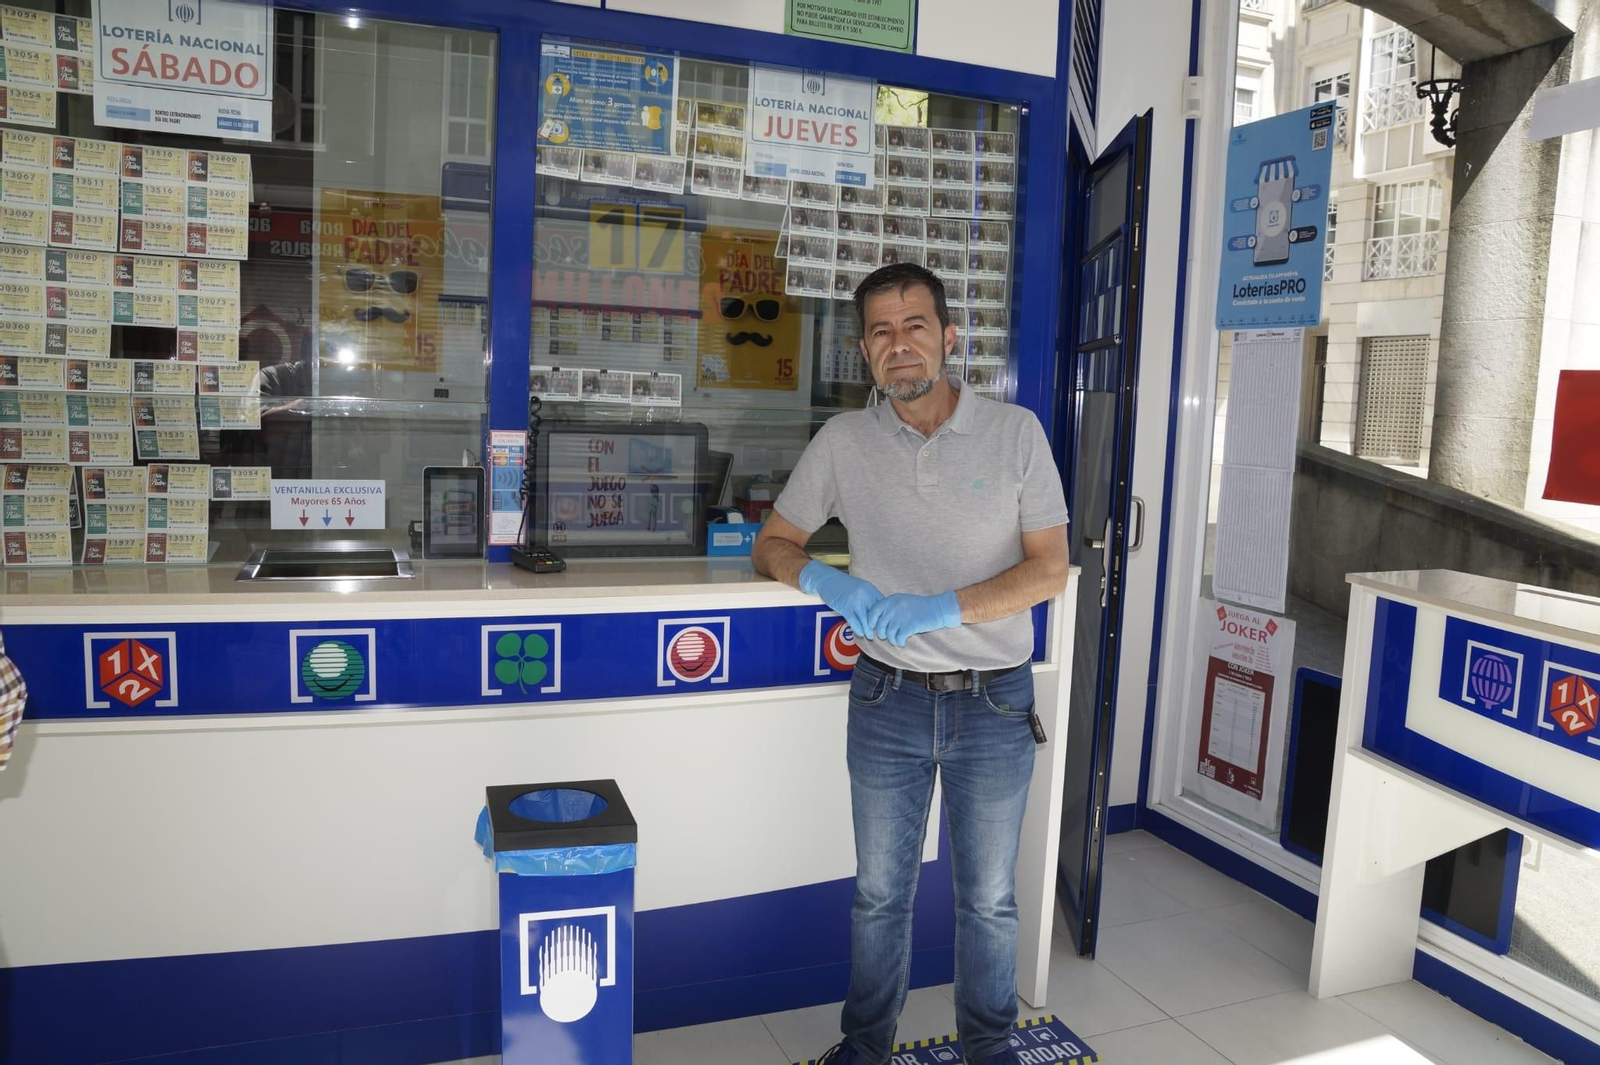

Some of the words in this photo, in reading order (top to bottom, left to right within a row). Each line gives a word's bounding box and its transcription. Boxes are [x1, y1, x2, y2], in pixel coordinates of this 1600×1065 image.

[4, 8, 37, 19] 13054
[807, 4, 827, 12] MOTIVOS
[834, 8, 857, 17] SEGURIDAD
[858, 12, 867, 20] ESTE
[868, 14, 904, 25] ESTABLECIMIENTO
[805, 11, 818, 19] PUEDE
[819, 14, 845, 23] GARANTIZAR
[888, 25, 904, 33] CAMBIO
[809, 20, 827, 28] BILLETES
[102, 25, 173, 45] LOTERÍA
[179, 35, 264, 56] NACIONAL
[8, 49, 39, 60] 13054
[111, 44, 259, 89] SÁBADO
[10, 89, 41, 99] 13054
[608, 97, 613, 106] 3
[754, 97, 804, 112] LOTERÍA
[809, 104, 868, 120] NACIONAL
[764, 115, 858, 147] JUEVES
[5, 132, 36, 142] 13067
[78, 141, 106, 151] 13511
[144, 149, 173, 157] 13516
[209, 155, 237, 163] 32860
[4, 170, 35, 180] 13067
[76, 177, 104, 187] 13511
[144, 186, 172, 194] 13516
[208, 190, 236, 198] 32860
[3, 208, 34, 218] 13067
[75, 215, 104, 224] 13511
[208, 226, 235, 234] 32860
[352, 216, 379, 237] DÍA
[386, 222, 413, 239] DEL
[595, 209, 683, 269] 17
[68, 253, 98, 261] 00360
[344, 237, 420, 266] PADRE
[135, 258, 163, 266] 35928
[726, 250, 748, 268] DÍA
[754, 255, 776, 270] DEL
[719, 268, 782, 295] PADRE
[1233, 278, 1306, 298] LoteríasPRO
[68, 290, 98, 298] 00360
[416, 334, 436, 355] 15
[776, 358, 793, 377] 15
[588, 439, 614, 454] CON
[588, 456, 600, 472] EL
[274, 486, 330, 494] VENTANILLA
[334, 486, 382, 494] EXCLUSIVA
[587, 477, 626, 492] JUEGO
[291, 497, 329, 506] Mayores
[344, 497, 366, 505] Años
[587, 495, 606, 509] NO
[611, 494, 624, 508] SE
[587, 511, 624, 528] JUEGA
[1228, 611, 1250, 622] JUEGA
[1220, 620, 1267, 644] JOKER
[1228, 662, 1238, 670] CON
[1239, 665, 1254, 675] JOKER
